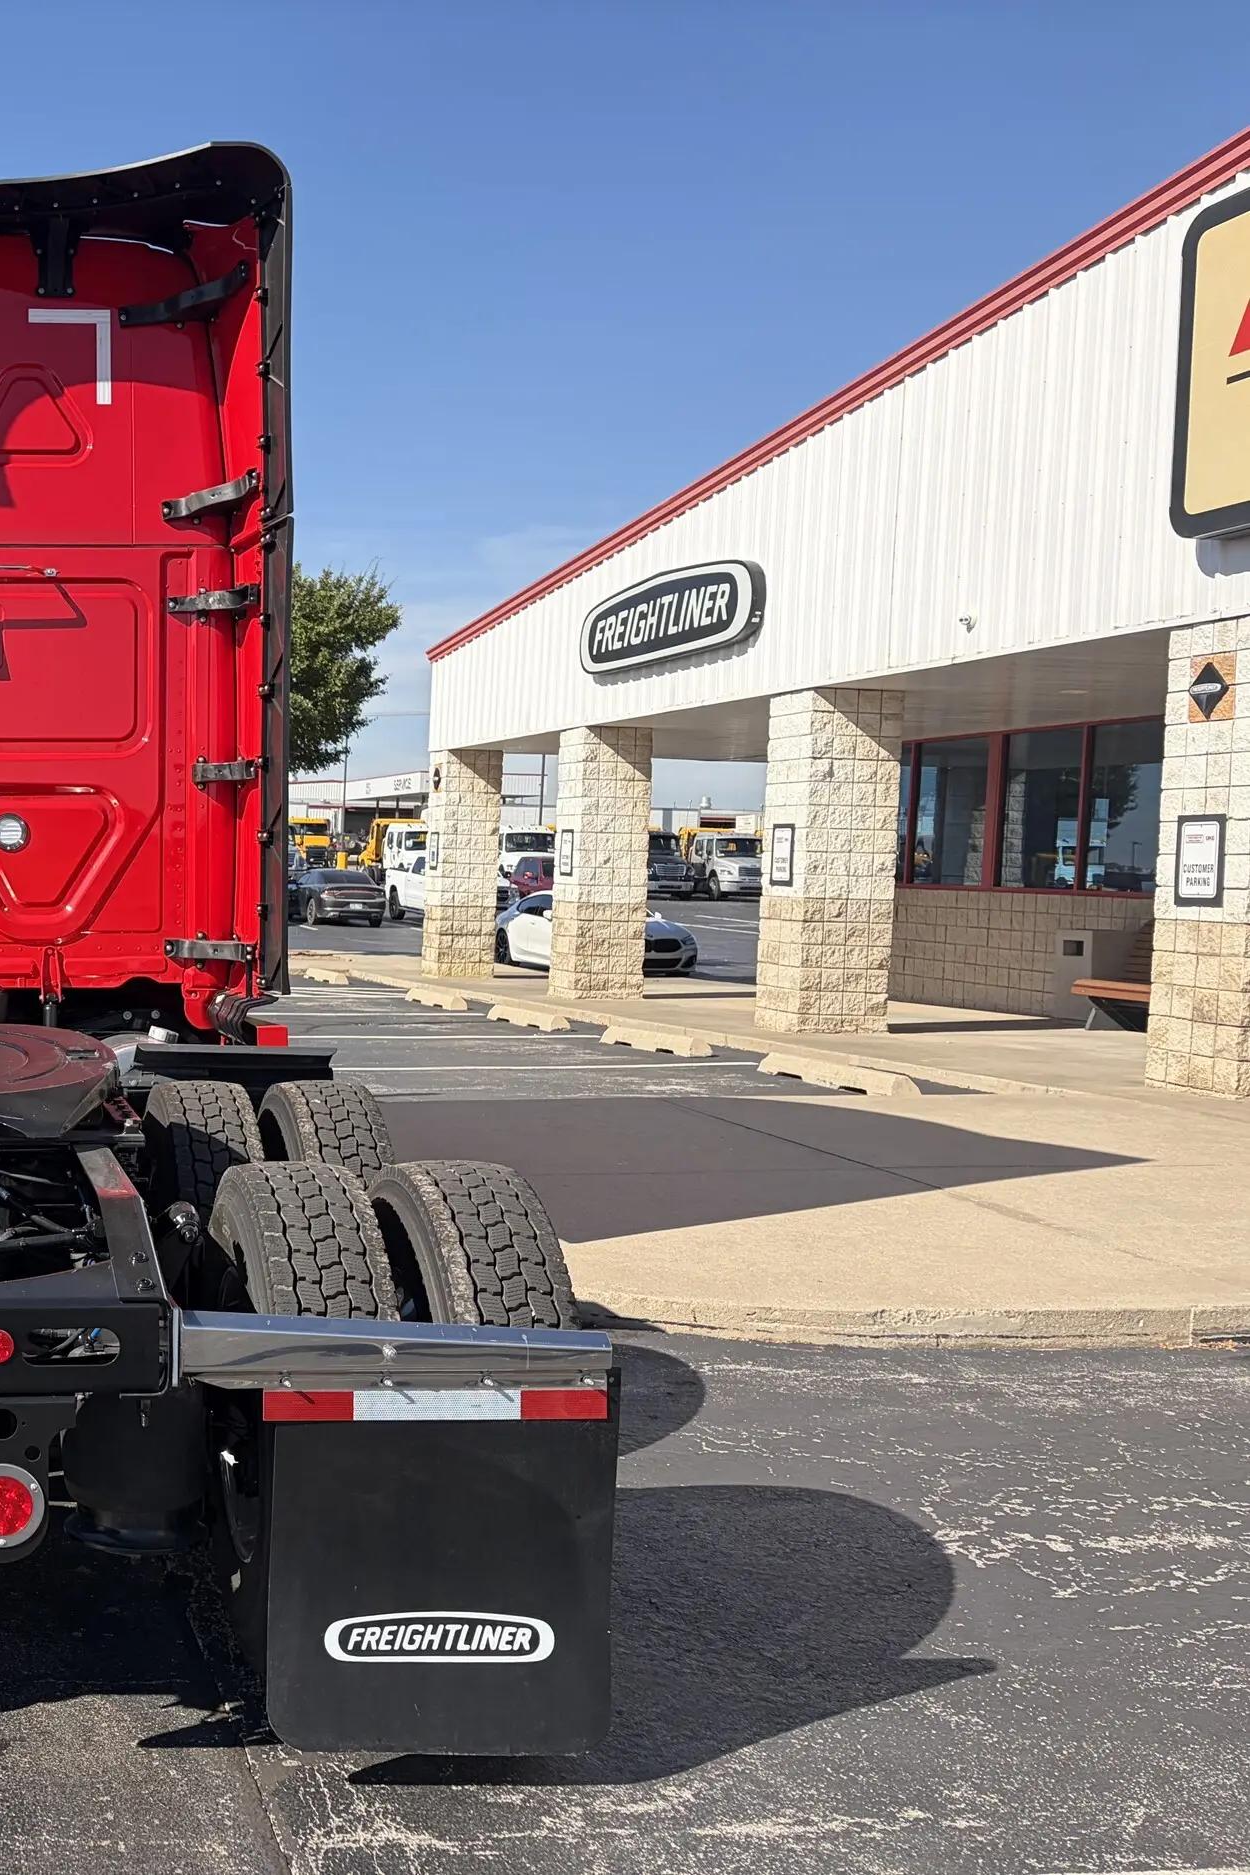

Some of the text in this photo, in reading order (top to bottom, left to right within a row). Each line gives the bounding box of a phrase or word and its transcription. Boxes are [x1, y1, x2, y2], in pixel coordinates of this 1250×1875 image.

[593, 583, 731, 656] FREIGHTLINER
[1183, 864, 1214, 874] CUSTOMER
[1186, 877, 1210, 887] PARKING
[347, 1623, 532, 1651] FREIGHTLINER
